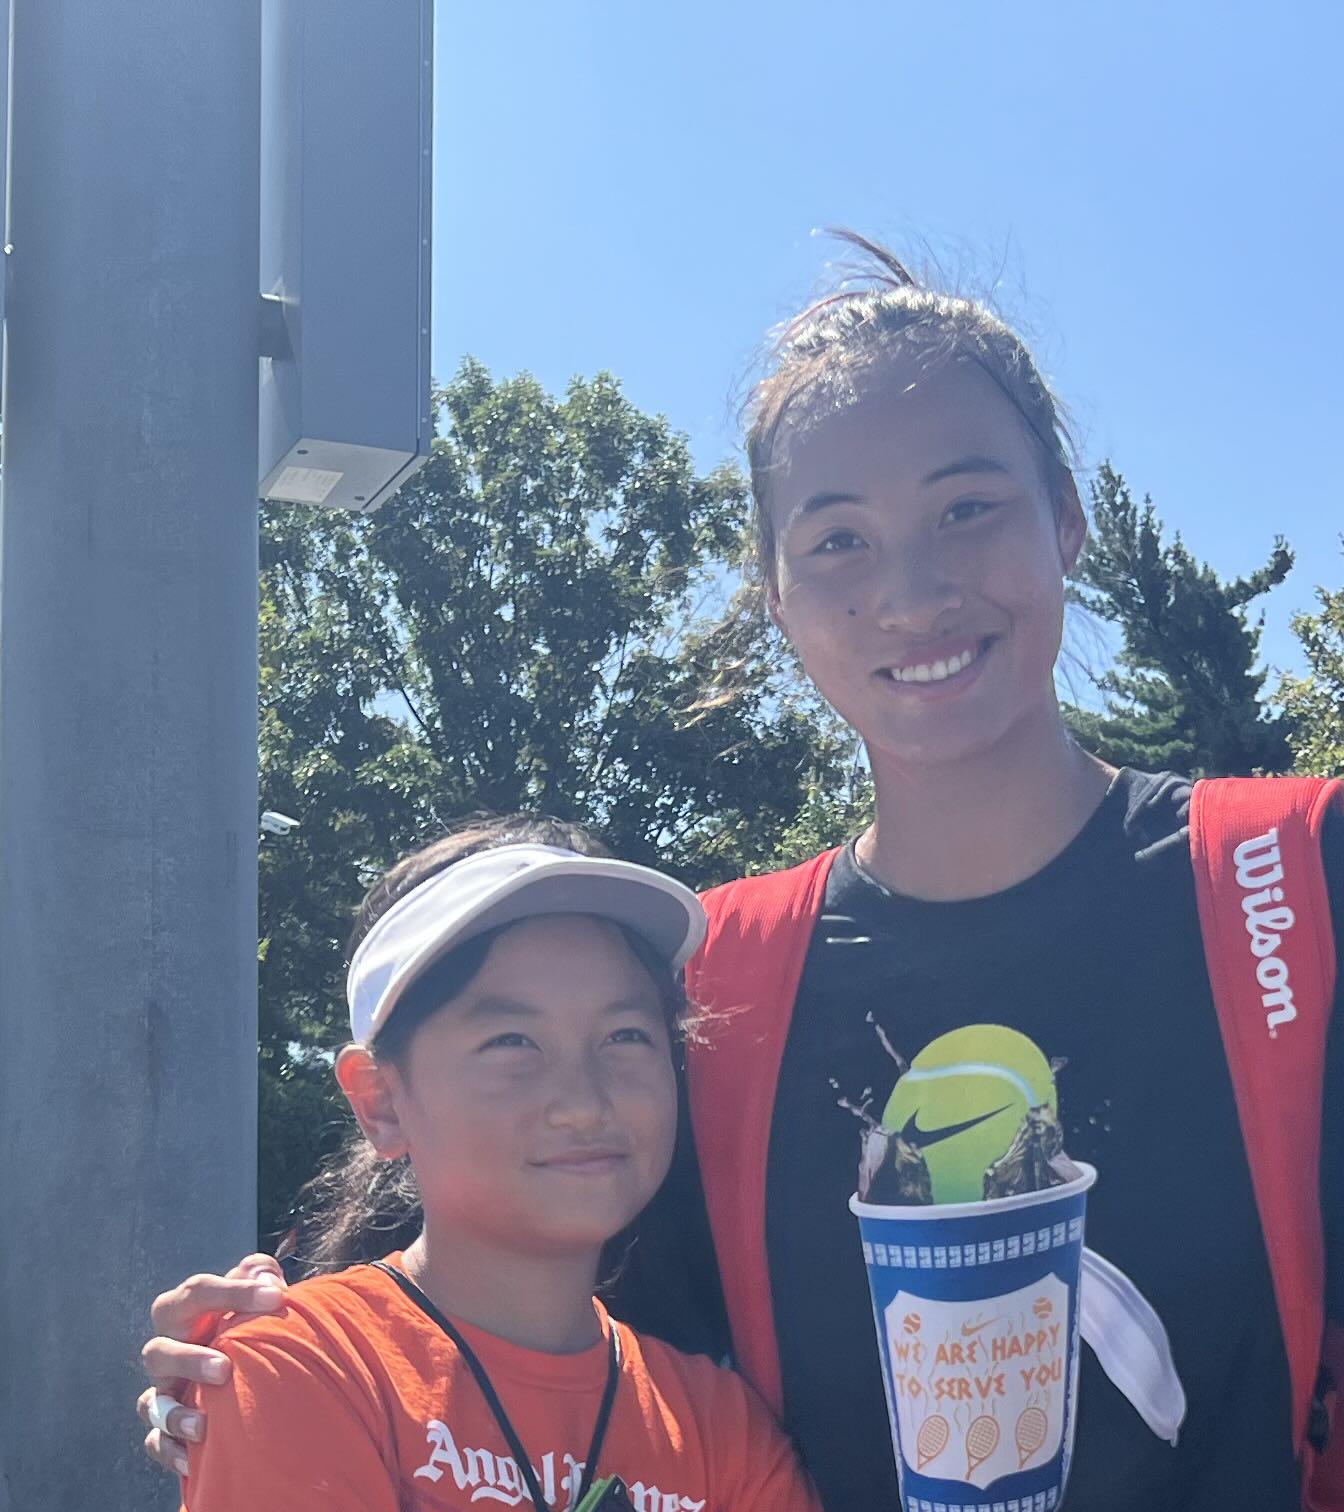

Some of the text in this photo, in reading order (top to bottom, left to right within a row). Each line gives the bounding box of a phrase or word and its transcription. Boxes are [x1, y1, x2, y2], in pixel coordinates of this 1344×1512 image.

[1233, 828, 1297, 1030] Wilson
[894, 1322, 1061, 1365] WE ARE HAPPY
[896, 1358, 1062, 1400] TO SERVE YOU
